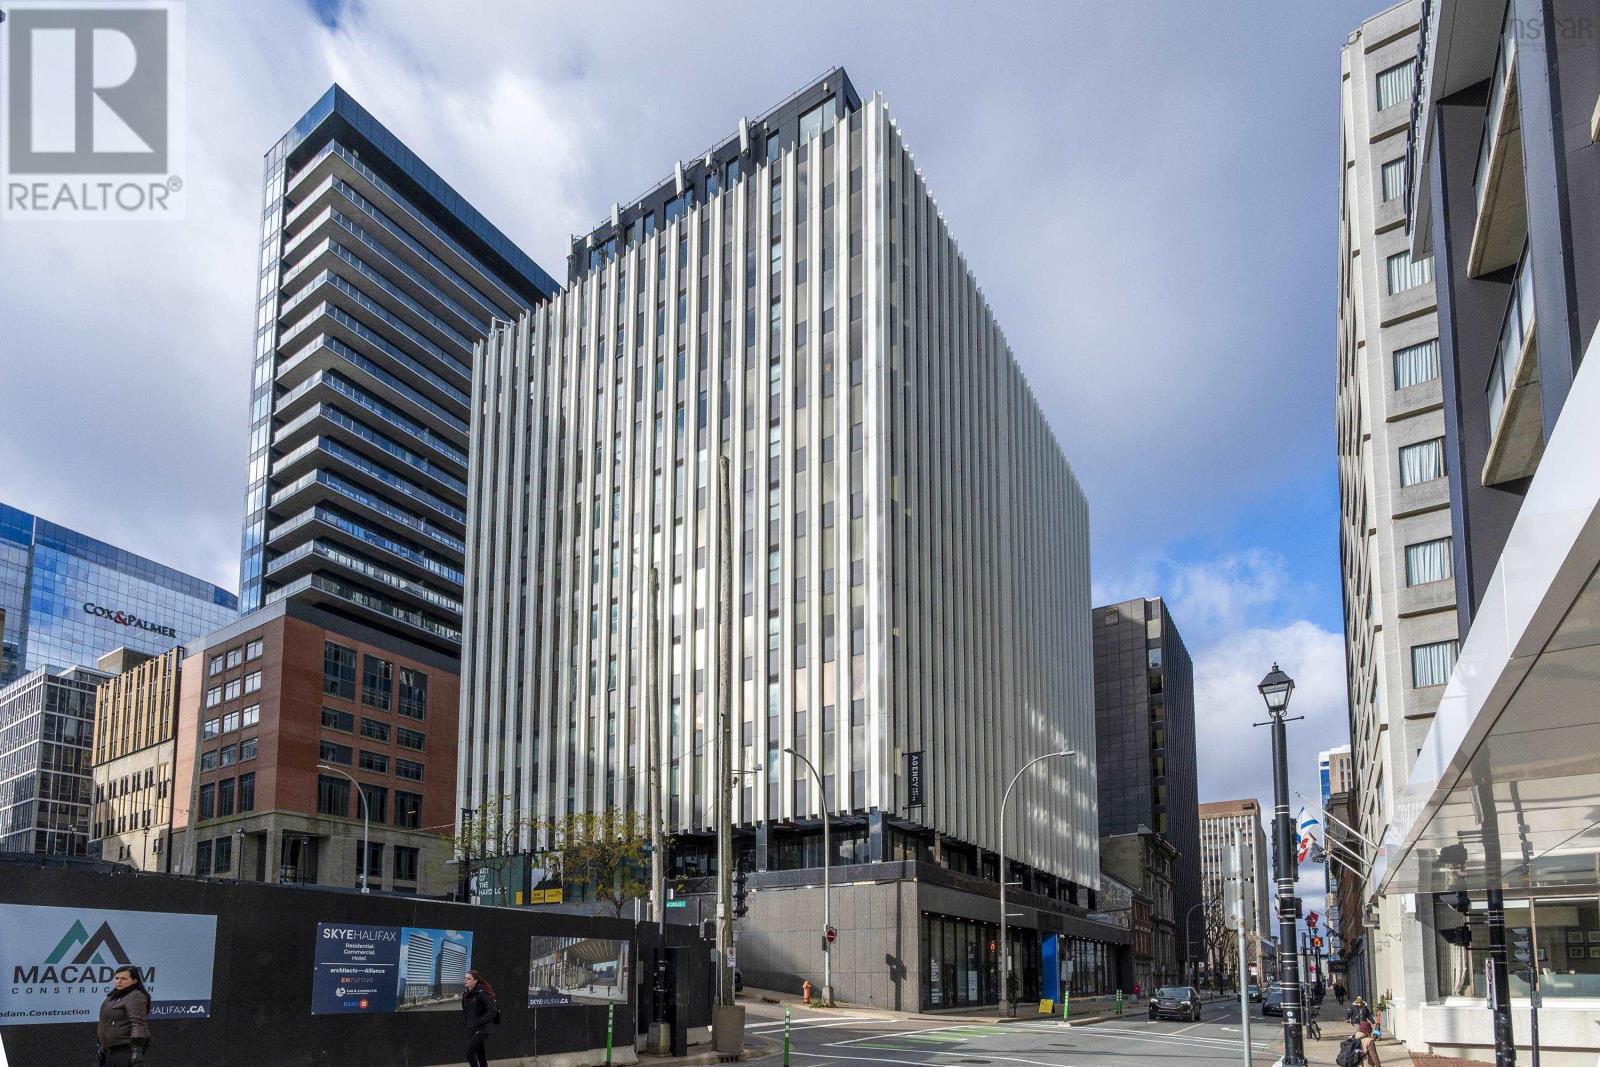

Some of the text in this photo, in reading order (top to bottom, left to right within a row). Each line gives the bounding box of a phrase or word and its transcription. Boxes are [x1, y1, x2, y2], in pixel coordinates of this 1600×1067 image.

[478, 887, 492, 896] HARD
[323, 928, 396, 941] SKYEHALIFAX
[13, 965, 156, 984] MACADM
[12, 986, 154, 995] CONSTRUCN
